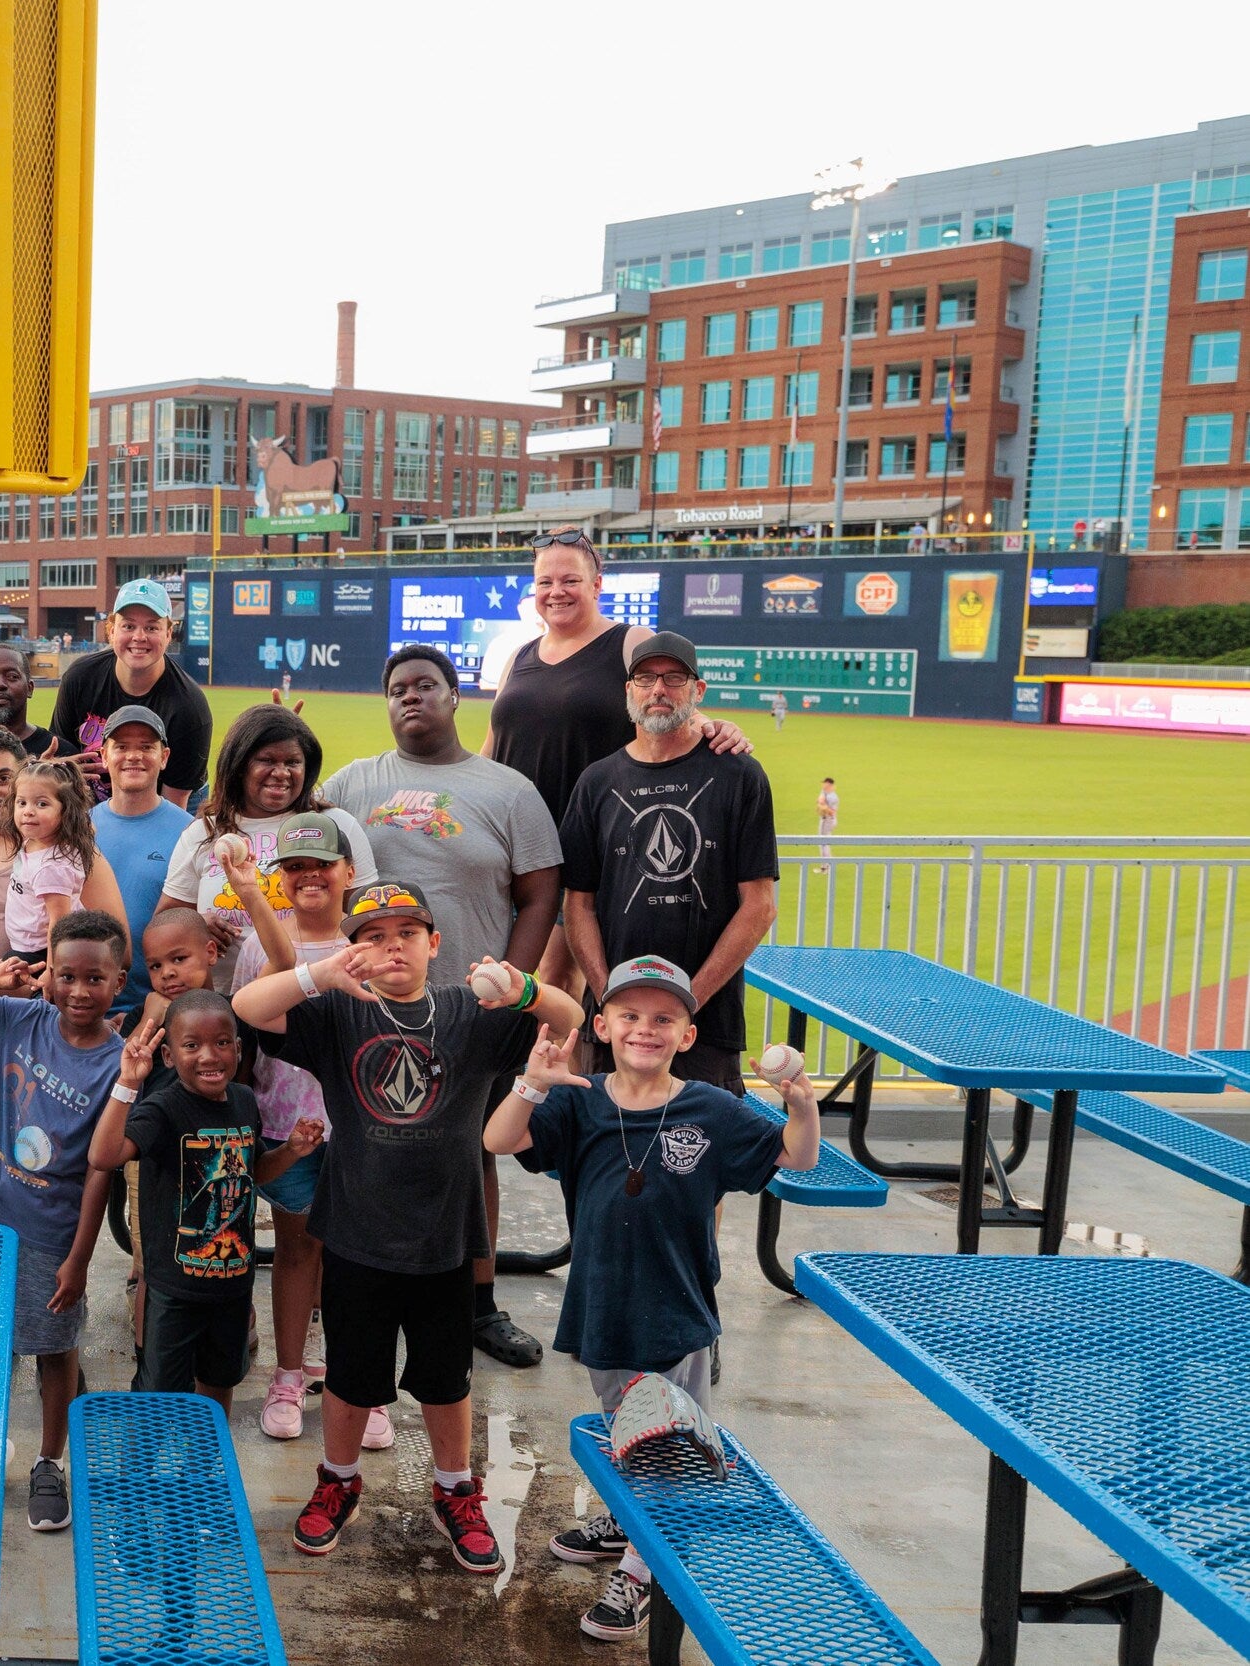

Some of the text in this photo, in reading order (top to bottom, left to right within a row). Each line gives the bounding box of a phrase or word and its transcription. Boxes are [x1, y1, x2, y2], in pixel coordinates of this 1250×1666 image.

[674, 505, 764, 523] Tobacco Road
[235, 584, 270, 607] CEI
[860, 587, 894, 600] CPI
[686, 595, 741, 608] jewelsmith
[311, 643, 341, 667] NC
[901, 653, 908, 662] E
[697, 658, 908, 672] NORFOLK 2 2 3 0
[703, 672, 907, 687] BULLS 4 4 2 0
[720, 691, 740, 701] BALLS
[630, 783, 689, 797] VOLCOM
[381, 789, 440, 811] NIKE
[704, 839, 718, 850] 91
[614, 846, 627, 857] 19
[647, 894, 693, 905] STONE
[15, 1044, 91, 1108] LEGEND
[186, 1126, 255, 1149] STAR
[675, 1131, 697, 1141] BUILT
[668, 1153, 676, 1163] TO
[676, 1157, 694, 1166] SLAM
[178, 1252, 251, 1279] WARS
